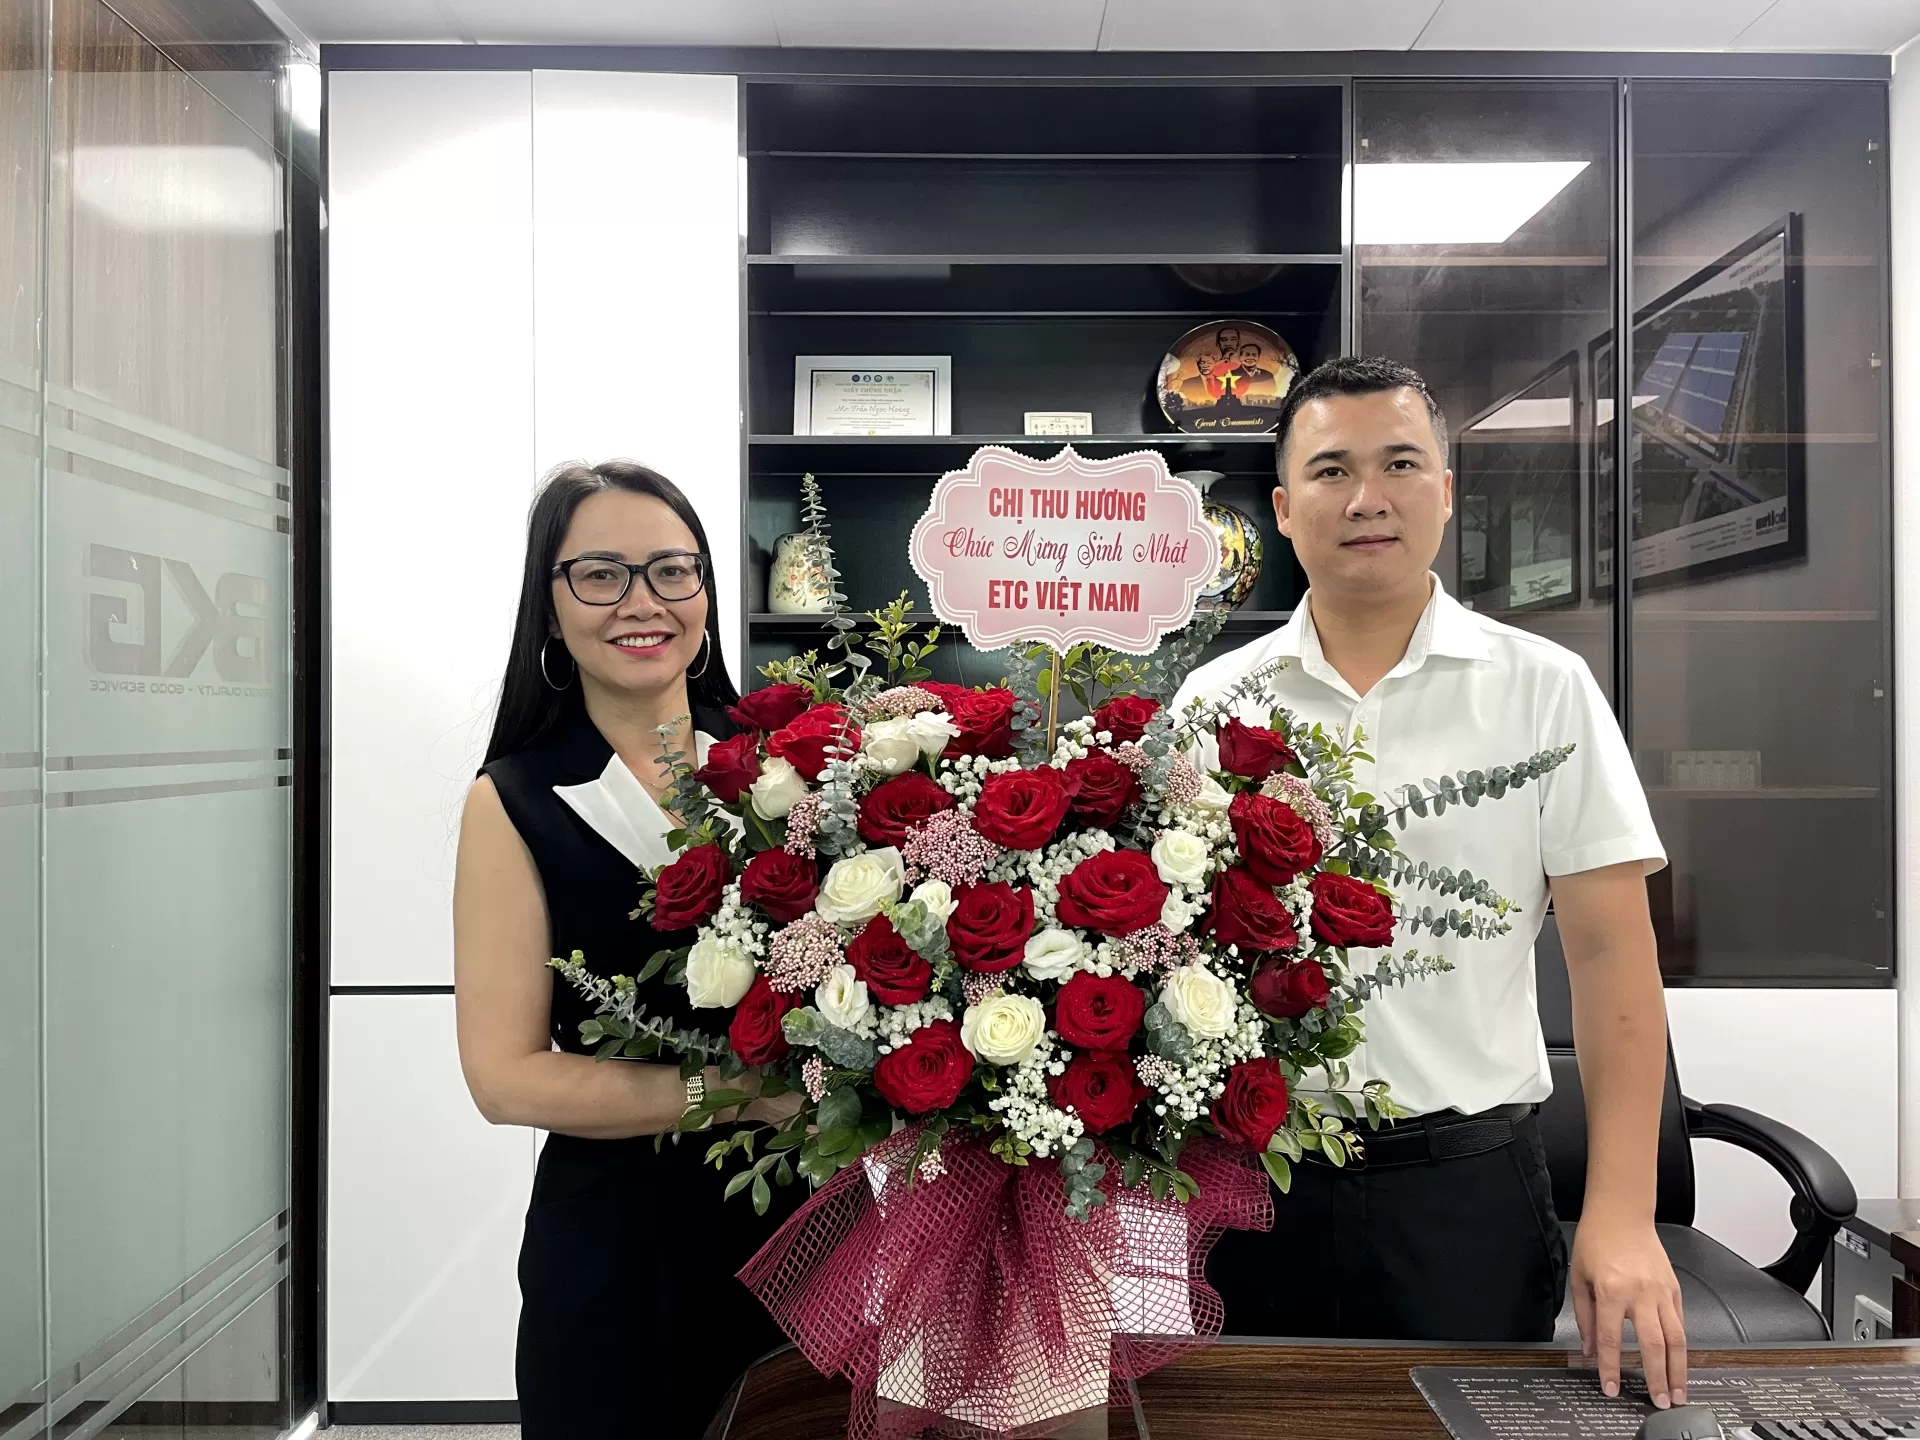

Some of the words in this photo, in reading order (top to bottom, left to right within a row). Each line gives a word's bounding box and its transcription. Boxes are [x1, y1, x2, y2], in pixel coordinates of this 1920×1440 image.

[1194, 417, 1217, 429] Great
[989, 487, 1023, 524] CHỊ
[1030, 489, 1069, 519] THU
[1075, 487, 1145, 521] HƯƠNG
[943, 527, 995, 558] Chúc
[1003, 528, 1069, 573] Mừng
[1077, 531, 1123, 569] Sinh
[1132, 532, 1189, 569] Nhật
[988, 579, 1028, 610] ETC
[1036, 575, 1082, 617] VIỆT
[1088, 582, 1140, 612] NAM
